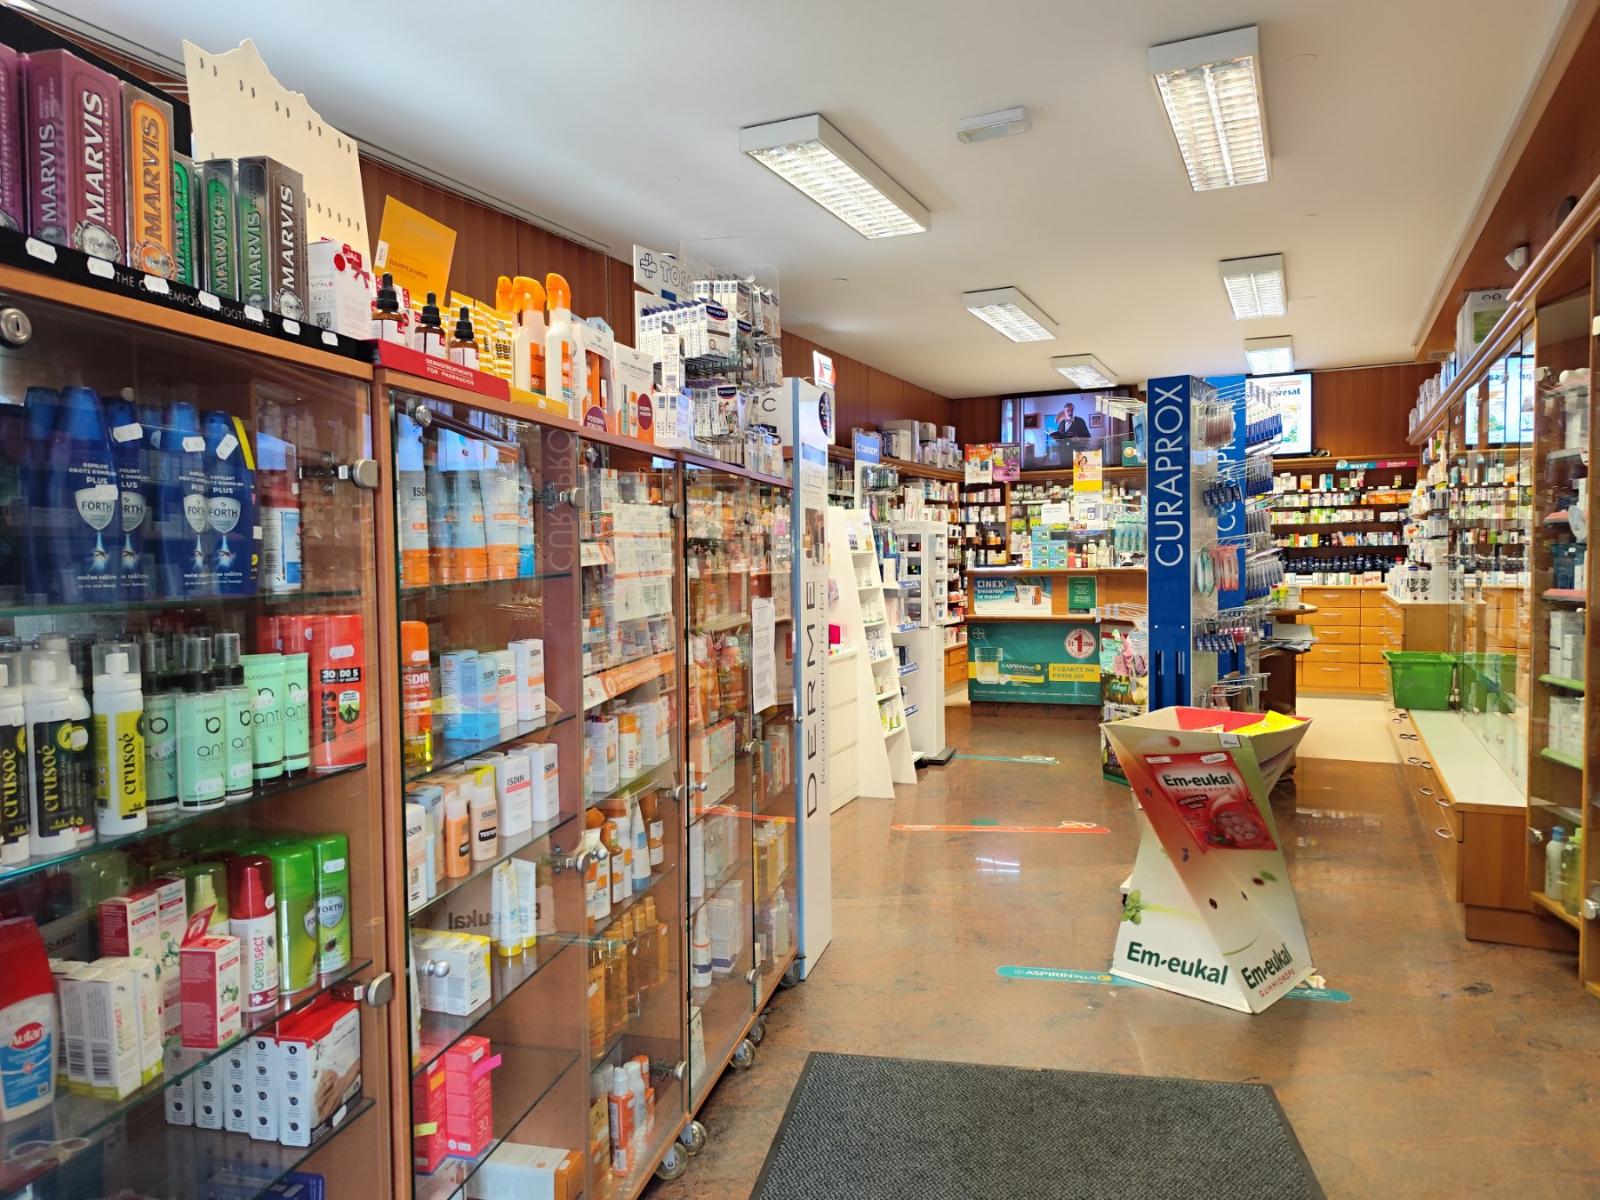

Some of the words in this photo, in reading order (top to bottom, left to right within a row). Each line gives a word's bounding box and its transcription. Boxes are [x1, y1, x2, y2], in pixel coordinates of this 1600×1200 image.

[40, 123, 57, 222] MARVIS
[83, 90, 105, 223] MARVIS
[141, 115, 162, 241] MARVIS
[213, 212, 228, 292] MARVIS
[247, 211, 263, 290] MARVIS
[280, 184, 294, 288] MARVIS
[115, 271, 135, 287] THE
[86, 476, 109, 485] PLUS
[1154, 383, 1183, 567] CURAPROX
[81, 500, 112, 512] FORTH
[123, 504, 143, 514] RTH
[208, 508, 238, 518] FORTH
[1074, 633, 1083, 653] 1
[806, 581, 817, 818] DERME
[37, 744, 59, 812] crusoé
[118, 733, 137, 795] crusoé
[506, 774, 525, 786] ISDIN
[1162, 772, 1236, 788] Em-eukal
[317, 902, 343, 914] FORTH
[252, 935, 264, 991] Greensect
[1025, 969, 1073, 979] ASPIRIN
[1127, 941, 1229, 985] Em-eukal
[1241, 942, 1293, 989] Em-eukal
[11, 1026, 43, 1046] Autan
